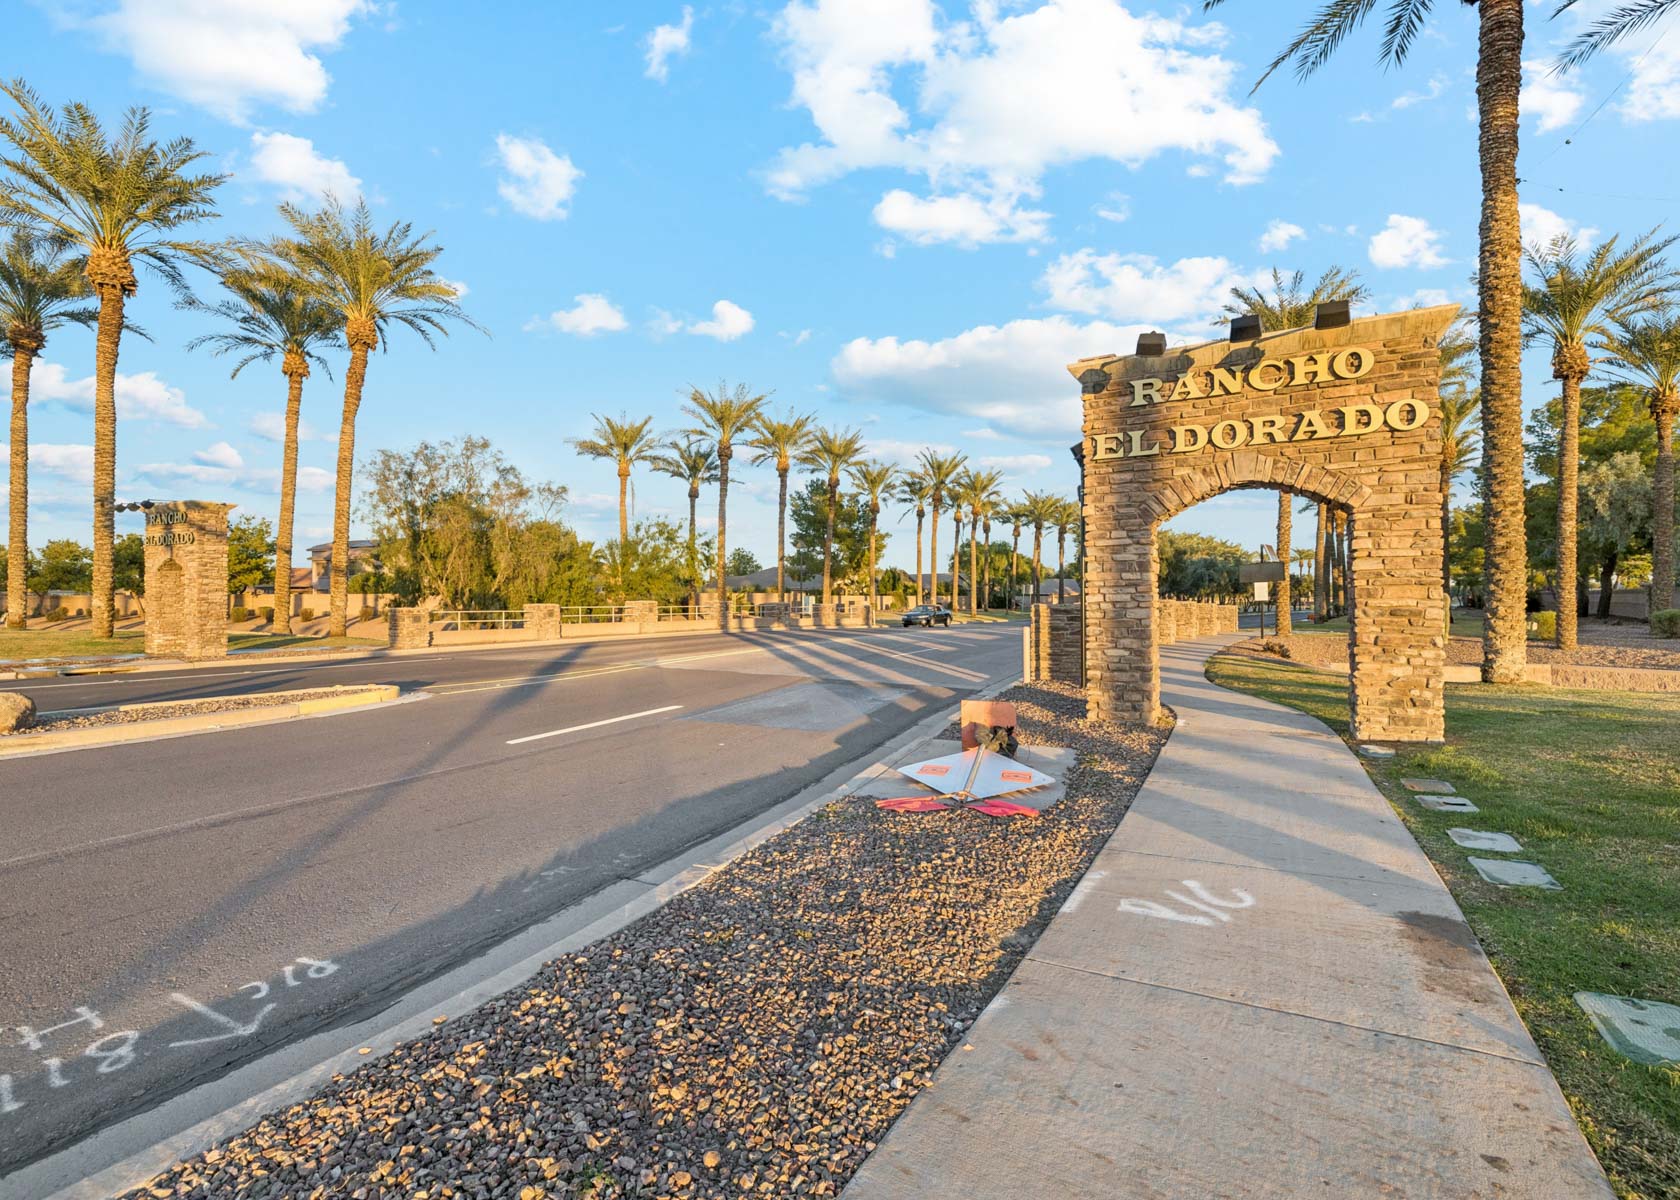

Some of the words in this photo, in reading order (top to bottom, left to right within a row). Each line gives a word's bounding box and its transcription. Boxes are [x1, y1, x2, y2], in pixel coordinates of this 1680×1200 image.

[1129, 347, 1375, 408] RANCHO
[1092, 430, 1160, 461] EL
[1170, 399, 1430, 454] DORADO
[150, 511, 188, 525] RANCHO
[144, 535, 157, 546] EL
[157, 531, 195, 546] DORADO
